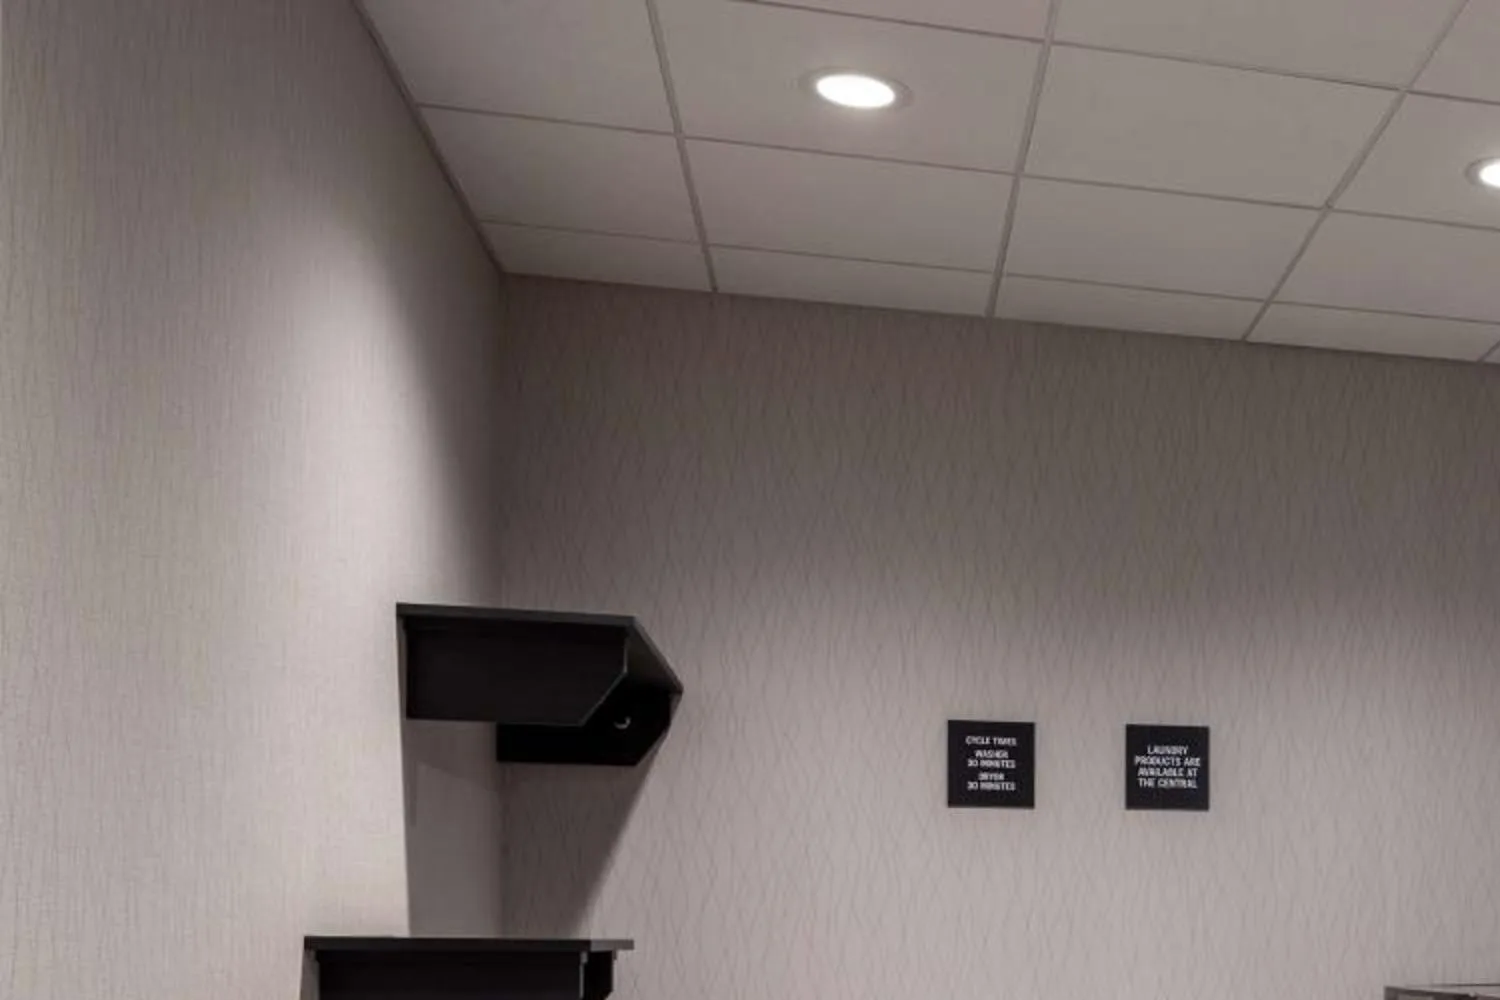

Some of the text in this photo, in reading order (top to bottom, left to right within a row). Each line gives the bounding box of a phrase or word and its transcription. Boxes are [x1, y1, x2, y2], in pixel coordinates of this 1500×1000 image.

[965, 735, 991, 745] CYCLE
[1147, 745, 1189, 755] LAUNDRY
[980, 759, 1016, 769] MINUTES
[1134, 755, 1201, 767] PRODUCTS ARE
[1137, 767, 1198, 777] AVAILABLE AT
[980, 781, 1016, 791] MINUTES
[1138, 777, 1198, 789] THE CENTRAL
